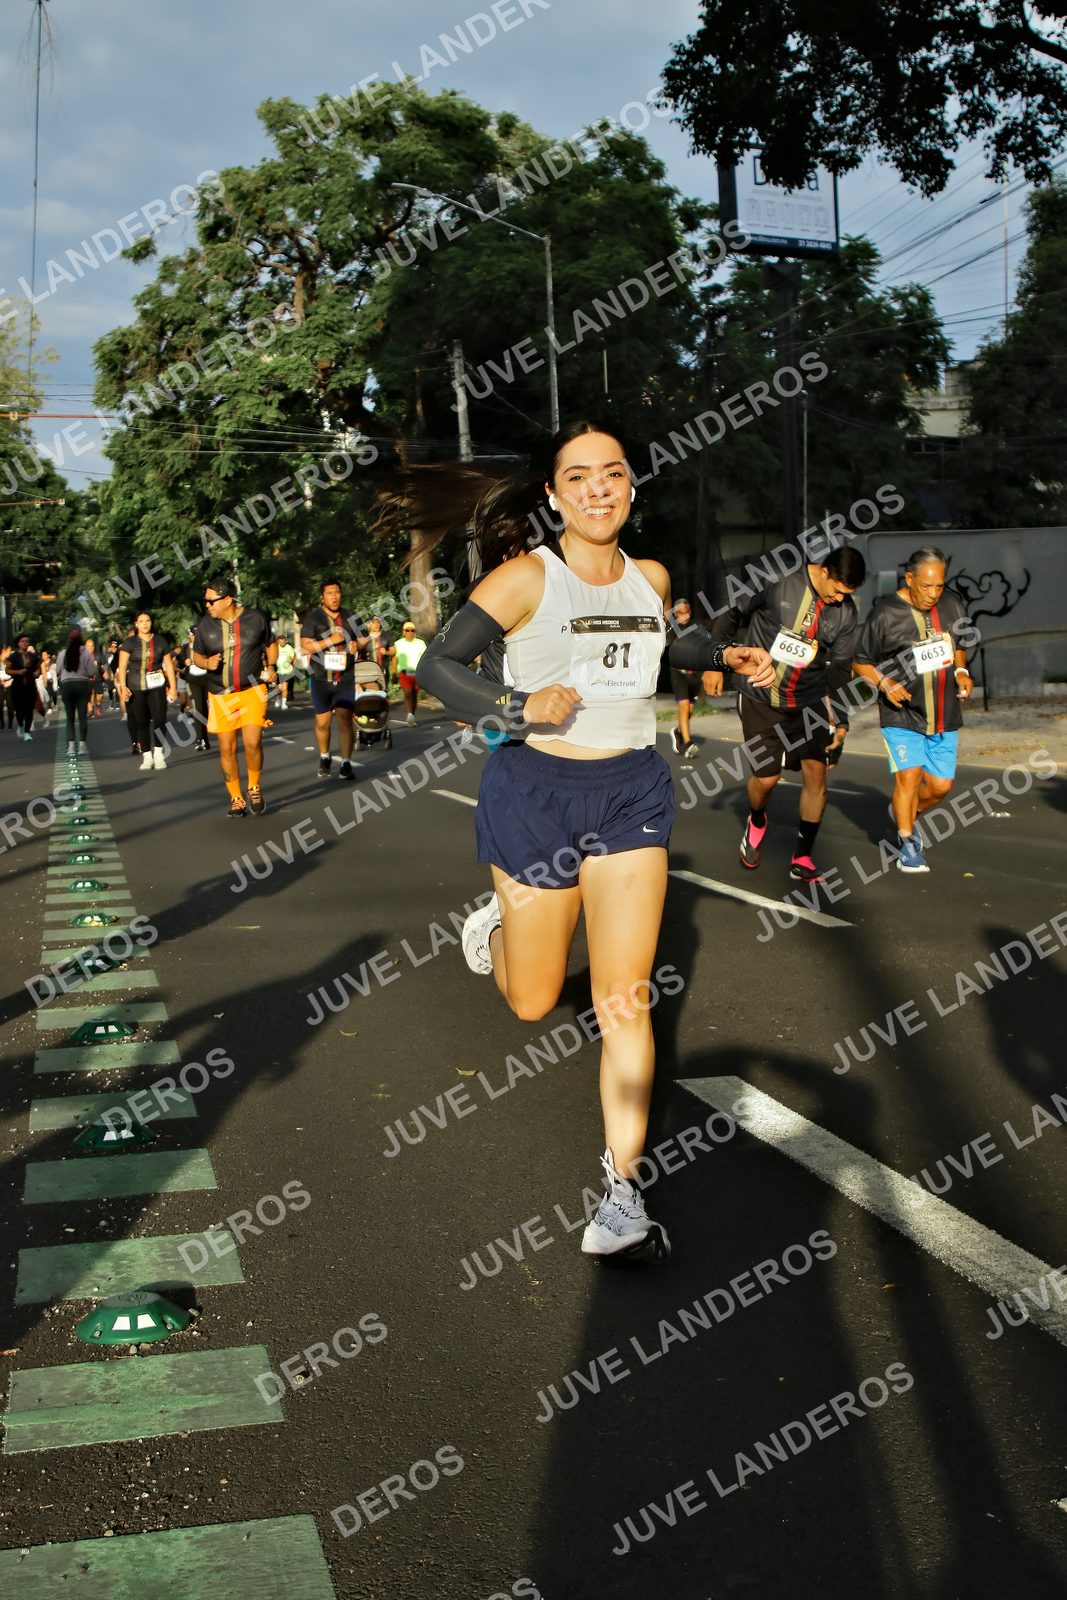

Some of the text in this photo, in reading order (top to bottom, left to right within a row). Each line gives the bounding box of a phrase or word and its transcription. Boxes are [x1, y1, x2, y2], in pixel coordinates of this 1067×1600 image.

[603, 642, 631, 668] 81
[779, 640, 807, 658] 6655
[921, 645, 945, 661] 6653
